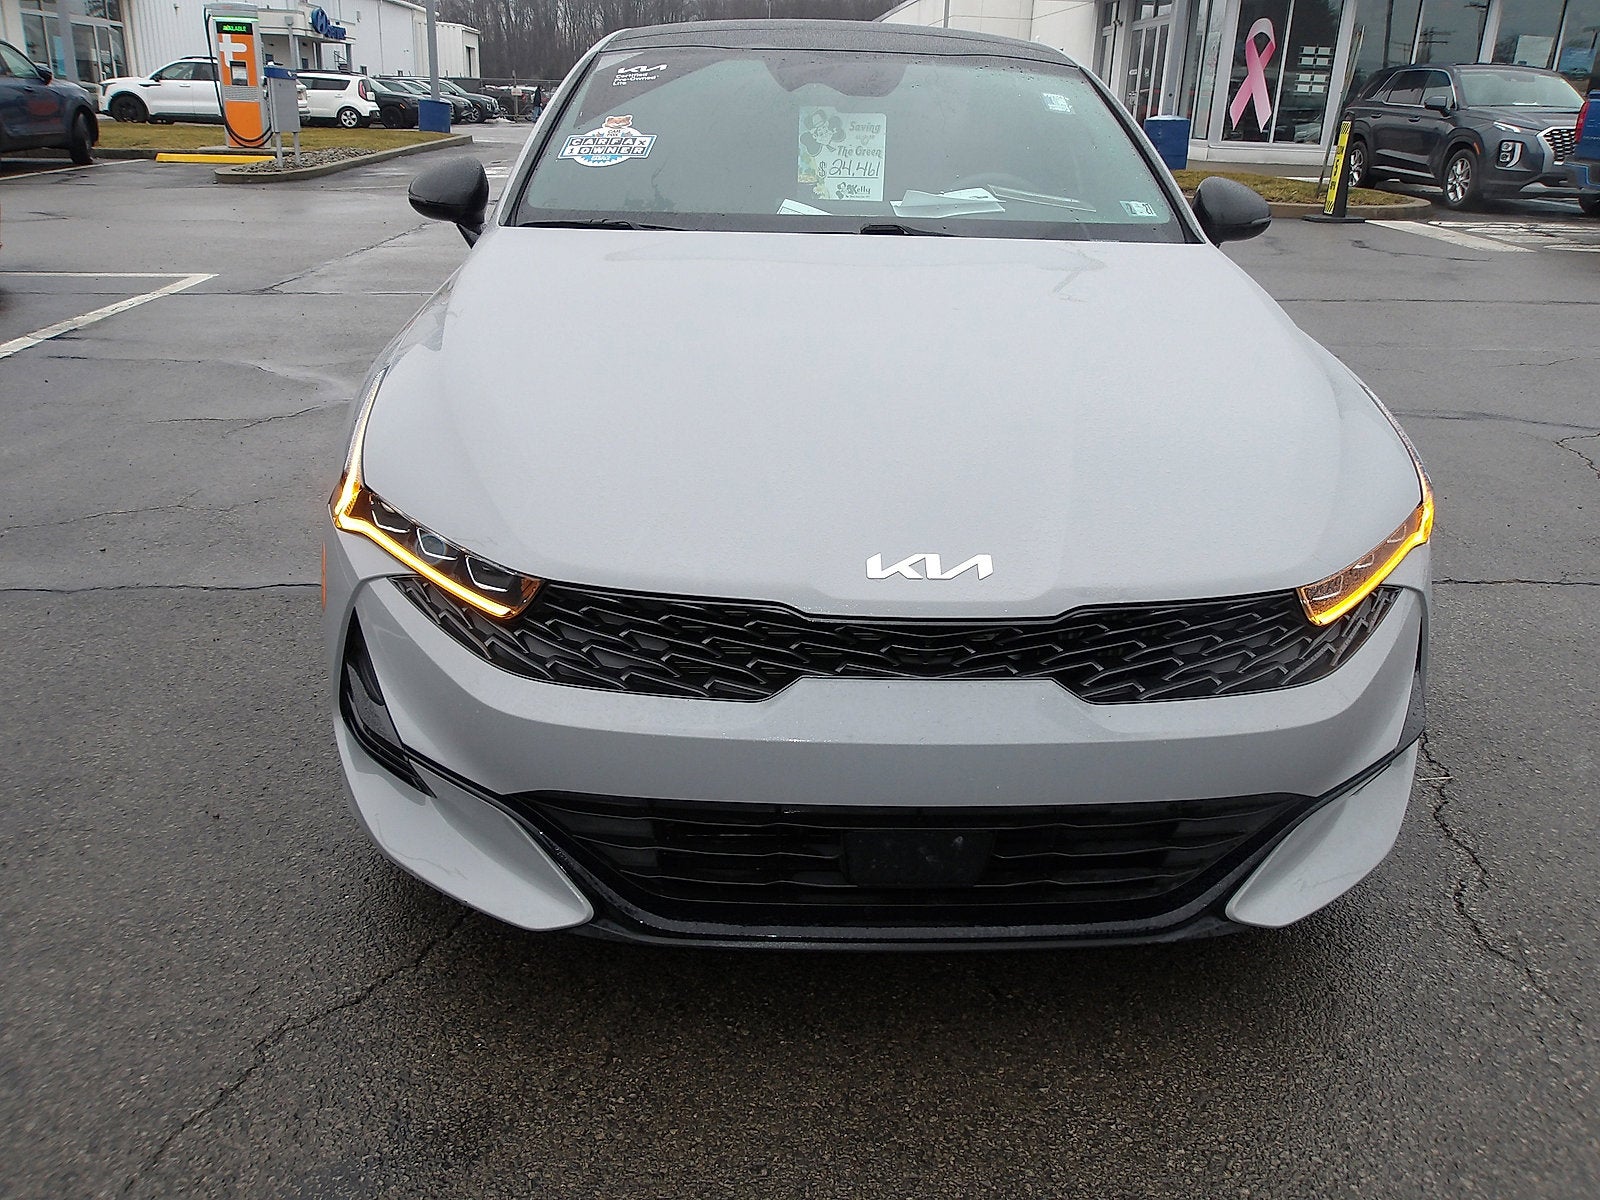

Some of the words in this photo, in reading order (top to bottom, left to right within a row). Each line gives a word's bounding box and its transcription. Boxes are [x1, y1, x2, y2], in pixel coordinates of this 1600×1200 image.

[569, 138, 647, 146] CARFAX
[577, 146, 645, 154] OWNER
[837, 145, 853, 158] The
[855, 146, 883, 159] Green
[818, 161, 827, 178] $
[852, 184, 871, 195] Kelly
[866, 552, 993, 580] KIA
